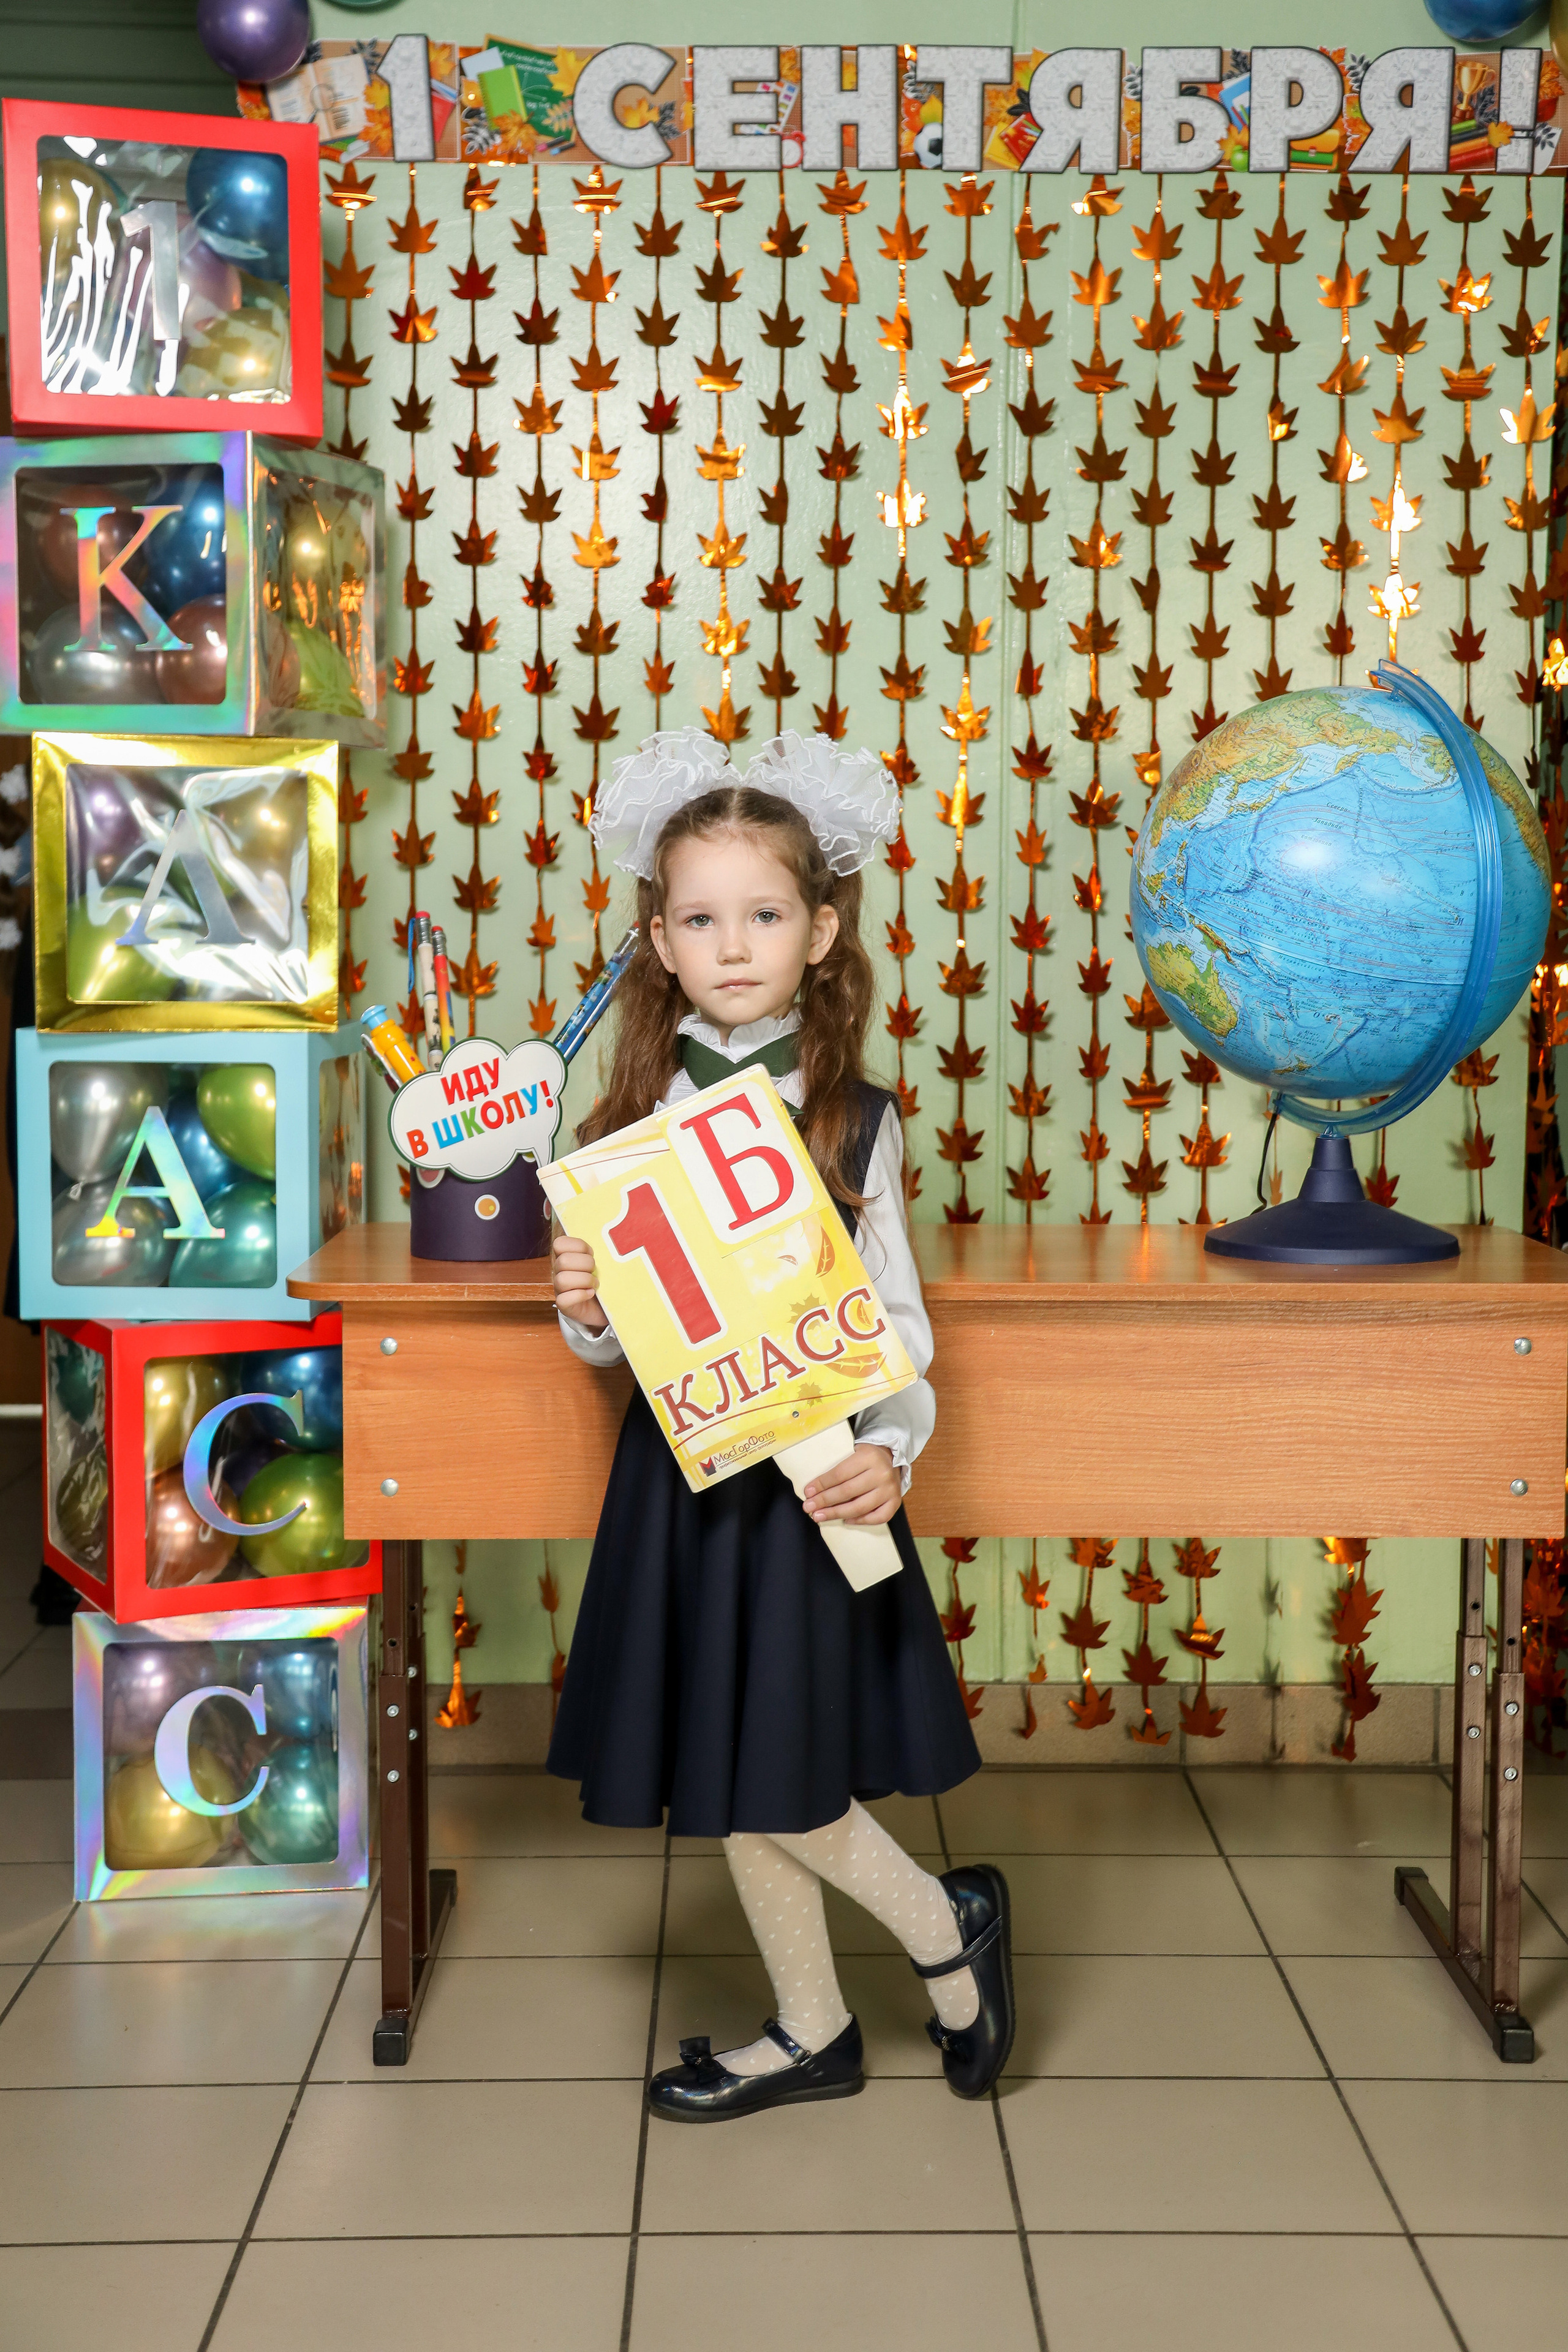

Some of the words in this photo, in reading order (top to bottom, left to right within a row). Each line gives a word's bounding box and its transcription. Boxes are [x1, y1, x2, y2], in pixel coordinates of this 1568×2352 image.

[377, 33, 436, 162] 1
[573, 42, 1542, 175] СЕНТЯБРЯ!
[119, 200, 182, 341] 1
[59, 504, 193, 652] К
[405, 1128, 429, 1159] В
[431, 1079, 554, 1150] ШКОЛУ!
[440, 1057, 500, 1106] ИДУ
[85, 1105, 226, 1239] А
[608, 1182, 722, 1345] 1
[679, 1093, 794, 1231] Б
[655, 1287, 887, 1436] КЛАСС
[713, 1430, 775, 1465] МосГорФото
